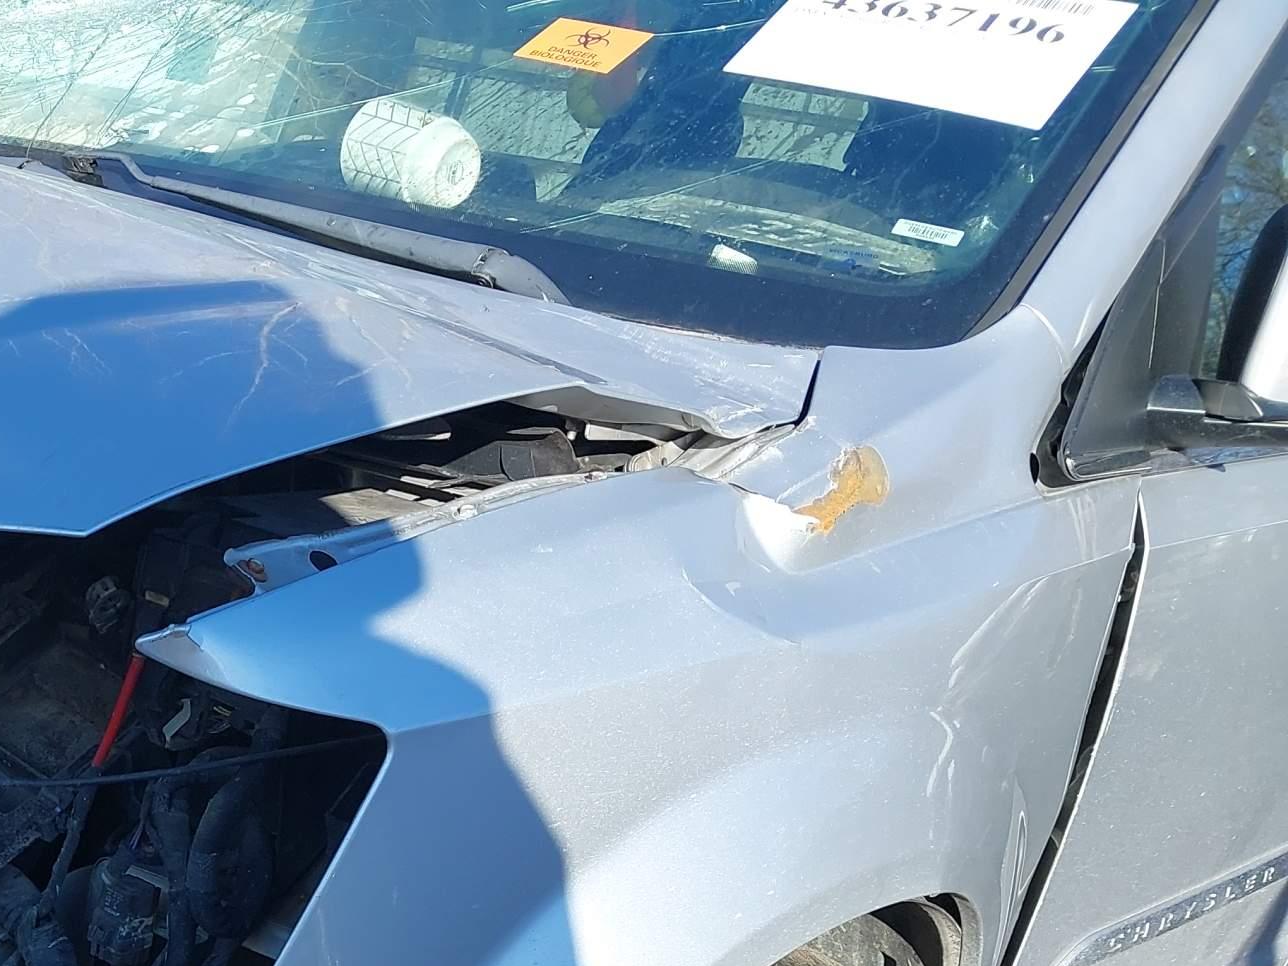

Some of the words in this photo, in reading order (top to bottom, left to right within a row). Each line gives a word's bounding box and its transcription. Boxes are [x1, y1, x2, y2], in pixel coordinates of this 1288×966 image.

[529, 49, 602, 68] BIOLOGIQUE
[548, 46, 598, 59] DANGER
[1109, 866, 1275, 952] CHRYSLER
